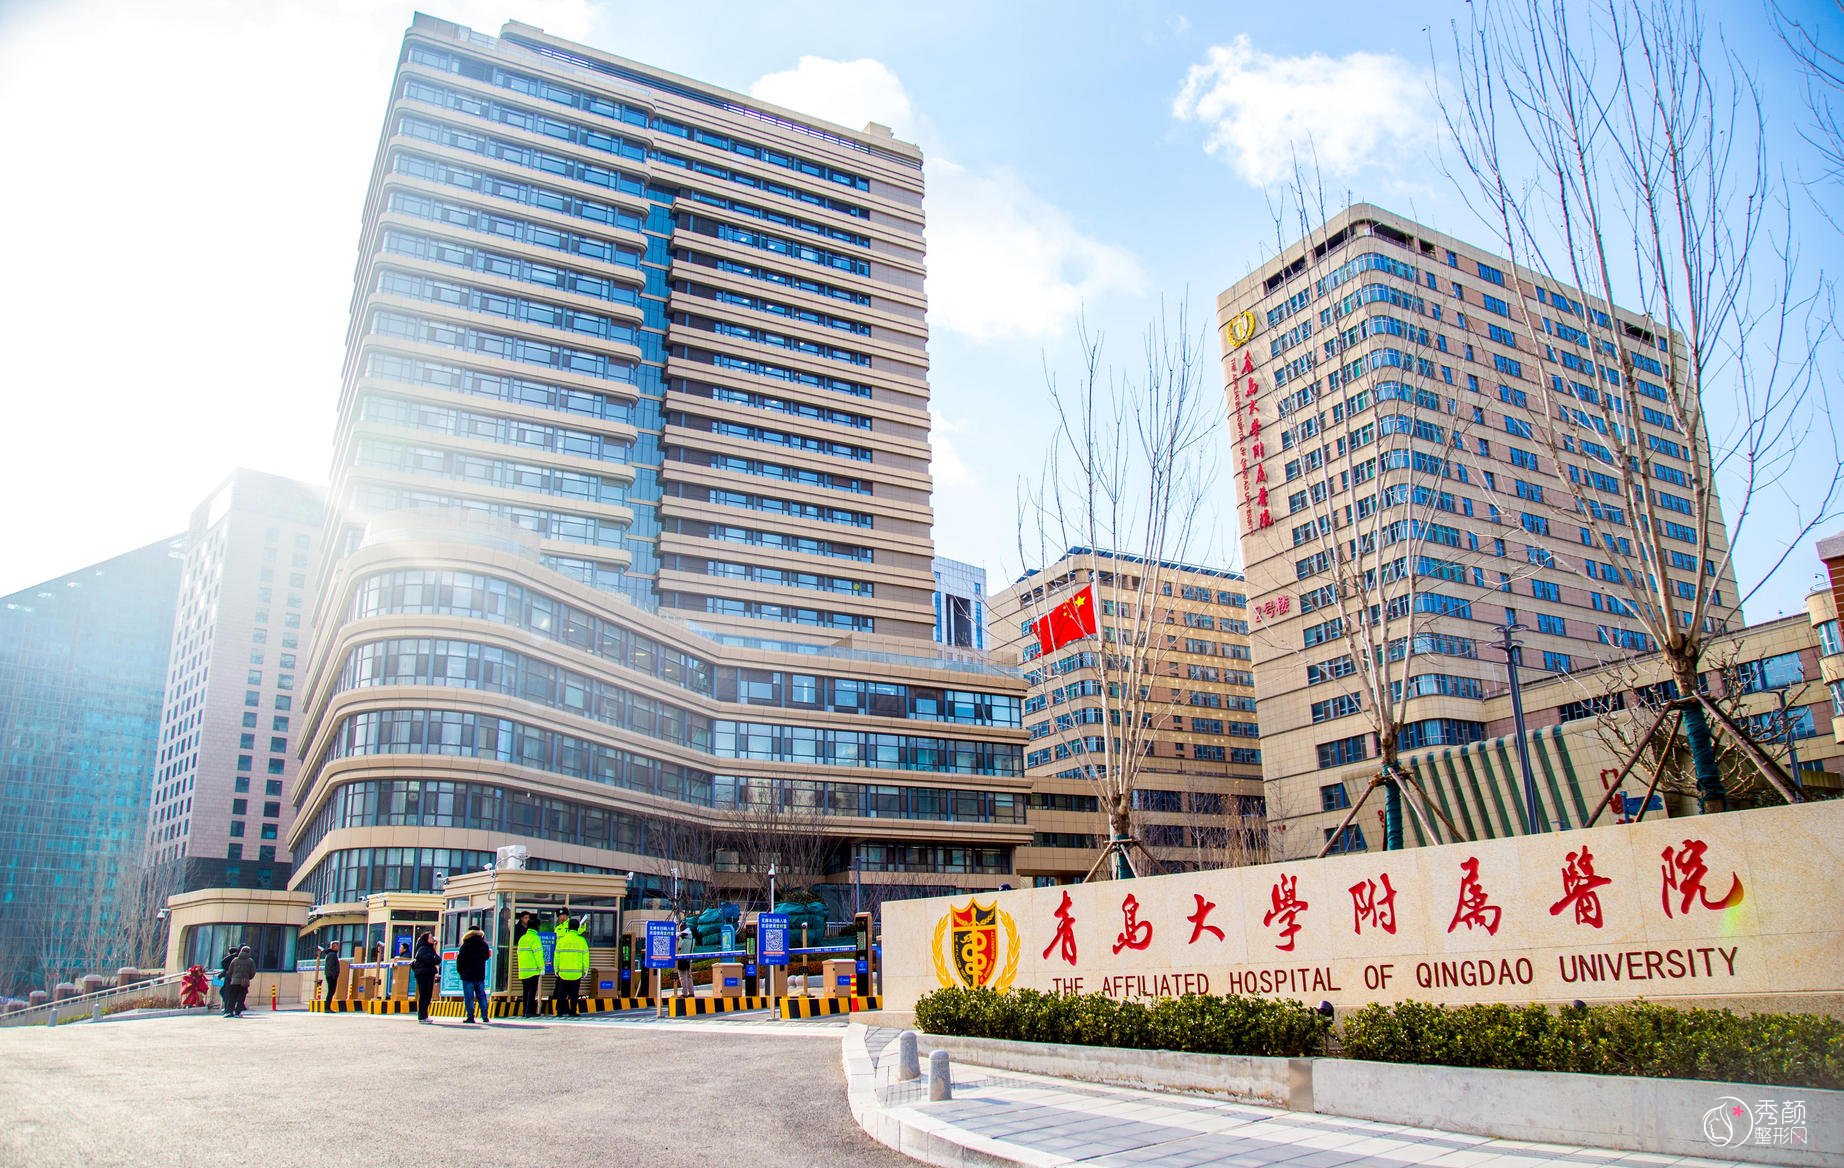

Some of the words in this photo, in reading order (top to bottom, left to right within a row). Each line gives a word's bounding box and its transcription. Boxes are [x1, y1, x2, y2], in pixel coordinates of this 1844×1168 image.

[1254, 595, 1290, 623] 2号楼
[1052, 977, 1084, 998] THE
[1102, 973, 1210, 998] AFFILIATED
[1229, 966, 1342, 994] HOSPITAL
[1364, 963, 1394, 990] OF
[1415, 956, 1535, 989] QINGDAO
[1558, 946, 1738, 983] UNIVERSITY
